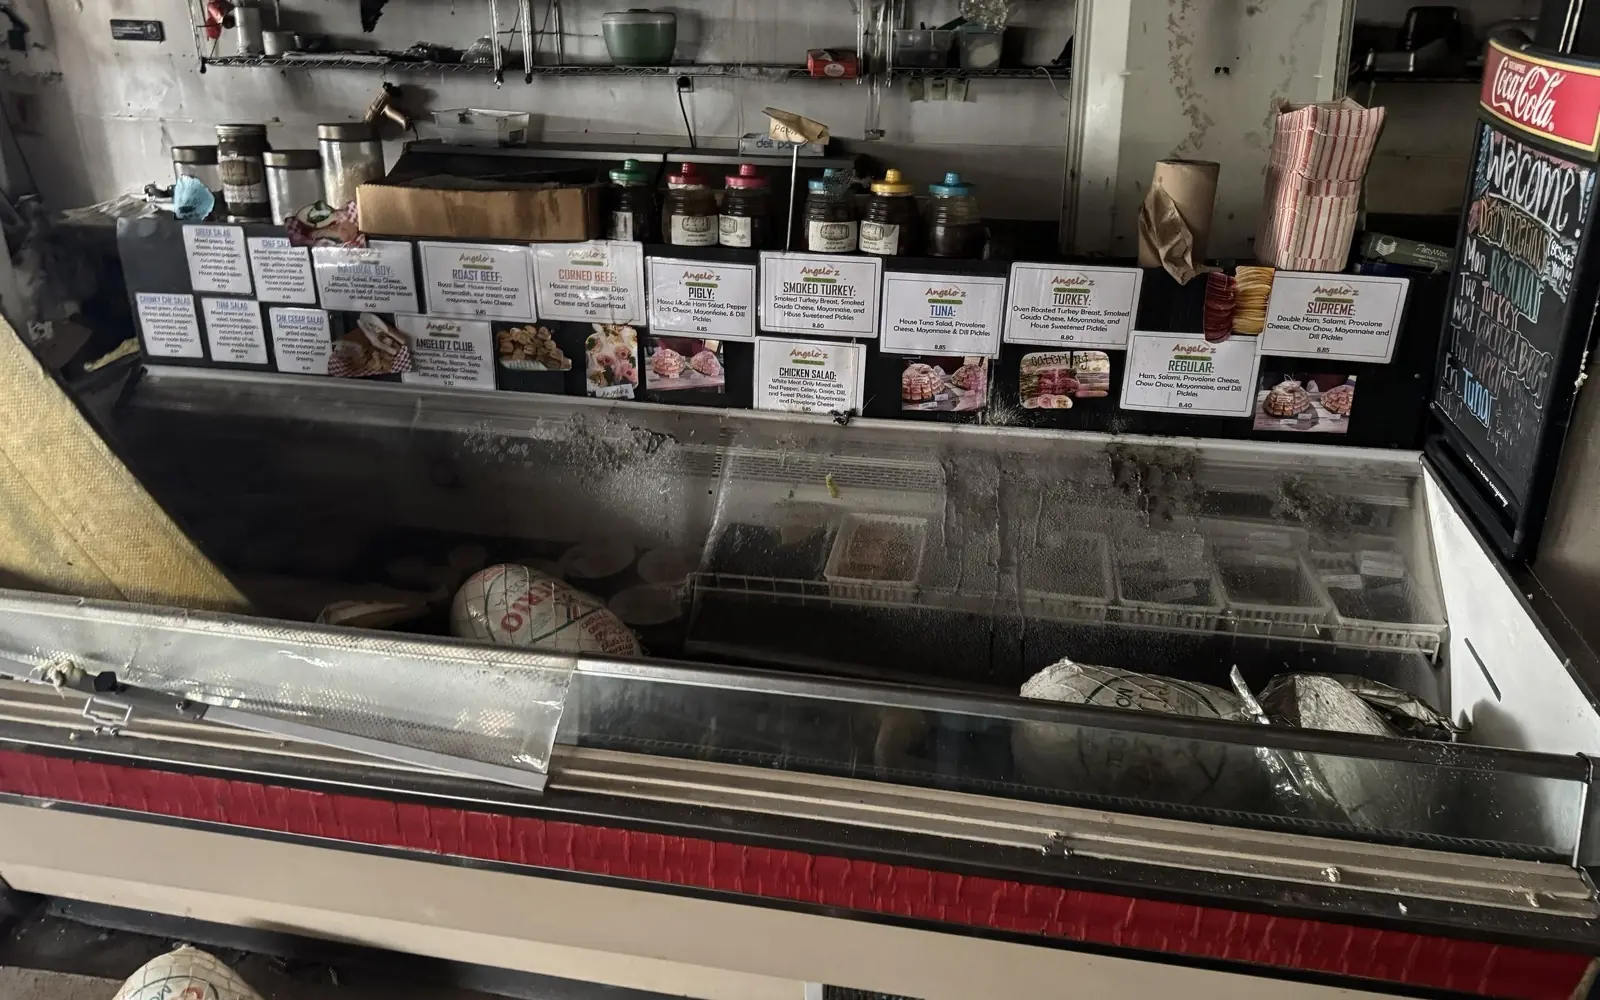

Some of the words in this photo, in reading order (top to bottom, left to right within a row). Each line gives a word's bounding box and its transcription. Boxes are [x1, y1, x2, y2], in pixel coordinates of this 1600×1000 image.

[1463, 237, 1487, 277] Mon.
[452, 269, 478, 280] ROAST
[480, 270, 503, 282] BEEF:
[559, 268, 592, 280] CORNED
[594, 271, 617, 283] BEEF:
[549, 282, 569, 290] House
[611, 285, 628, 294] Dijon
[688, 287, 715, 300] PIGLY:
[783, 281, 818, 295] SMOKED
[820, 284, 856, 297] TURKEY:
[591, 302, 626, 310] Sauerkraut
[692, 300, 707, 308] Ham
[707, 301, 725, 309] Salad,
[774, 295, 798, 303] Smoked
[799, 296, 819, 304] Turkey
[1053, 293, 1092, 306] TURKEY:
[1459, 272, 1480, 305] Tue.
[1481, 281, 1518, 331] Turkey
[693, 308, 729, 317] Mayonnaise,
[783, 310, 801, 318] House
[802, 312, 834, 320] Sweetened
[834, 312, 855, 321] Pickles
[794, 304, 815, 312] Cheese,
[816, 305, 852, 314] Mayonnaise,
[930, 304, 957, 317] TUNA:
[1013, 305, 1030, 313] Oven
[1030, 306, 1056, 314] Roasted
[1057, 307, 1080, 316] Turkey
[1080, 308, 1102, 317] Breast,
[1103, 309, 1130, 317] Smoked
[1306, 301, 1356, 317] SUPREME:
[1452, 298, 1475, 333] Wed.
[935, 320, 954, 328] Salad,
[955, 321, 986, 329] Provolone
[1020, 313, 1042, 321] Gouda
[1043, 314, 1066, 323] Cheese,
[1066, 316, 1106, 326] Mayonnaise,
[1277, 315, 1301, 323] Double
[1302, 316, 1320, 324] Ham,
[1322, 317, 1346, 325] Salami,
[1348, 319, 1383, 328] Provolone
[893, 325, 915, 333] Cheese,
[916, 326, 951, 335] Mayonnaise
[1050, 323, 1086, 331] Sweetened
[1086, 324, 1108, 332] Pickles
[1267, 323, 1291, 331] Cheese,
[1313, 325, 1333, 333] Chow,
[1334, 327, 1374, 337] Mayonnaise
[1375, 329, 1389, 337] and
[1308, 332, 1320, 340] Dill
[1320, 334, 1344, 342] Pickles
[416, 338, 452, 350] ANGELO'Z
[453, 341, 476, 352] CLUB:
[1168, 359, 1215, 374] REGULAR:
[779, 367, 810, 378] CHICKEN
[812, 369, 837, 380] SALAD:
[1138, 372, 1157, 381] Ham,
[1158, 373, 1182, 381] Salami,
[1183, 374, 1216, 383] Provolone
[1217, 376, 1241, 385] Cheese,
[779, 385, 799, 393] Pepper,
[1154, 381, 1175, 389] Chow,
[1176, 383, 1216, 392] Mayonnaise,
[1217, 384, 1230, 392] and
[1231, 384, 1242, 392] Dill
[1445, 352, 1460, 394] Fri.
[1462, 367, 1488, 424] Tuna
[1176, 390, 1199, 398] Pickles
